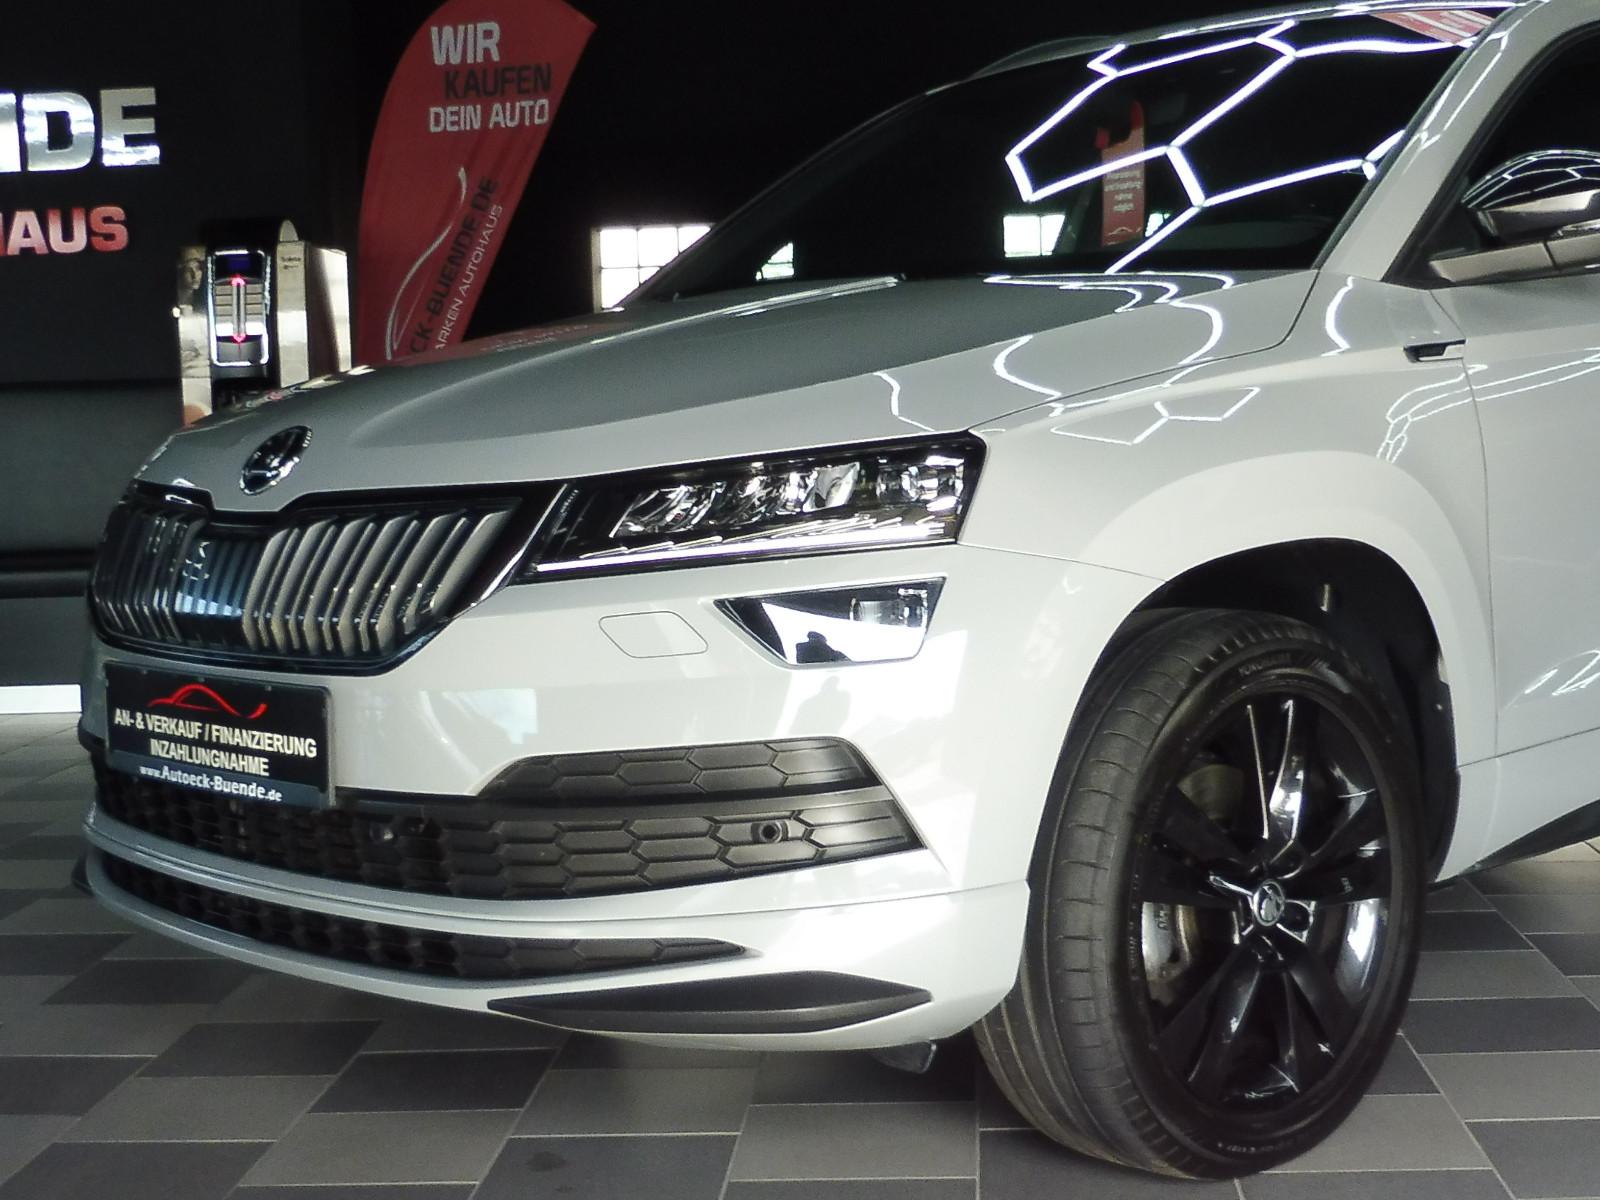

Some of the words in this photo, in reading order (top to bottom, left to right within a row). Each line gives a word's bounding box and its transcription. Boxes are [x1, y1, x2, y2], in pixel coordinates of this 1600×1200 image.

[430, 21, 500, 65] WIR
[445, 63, 553, 99] KAUFEN
[0, 87, 160, 172] DE
[429, 105, 482, 132] DEIN
[489, 98, 549, 129] AUTO
[0, 206, 129, 257] AUS
[458, 204, 503, 298] AUTOHAUS
[135, 711, 145, 730] &
[145, 713, 203, 739] VERKAUF
[211, 724, 318, 758] FINANZIERUNG
[150, 738, 270, 777] INZAHLUNGNAHME
[139, 764, 283, 801] www.Autoeck-Buende.de
